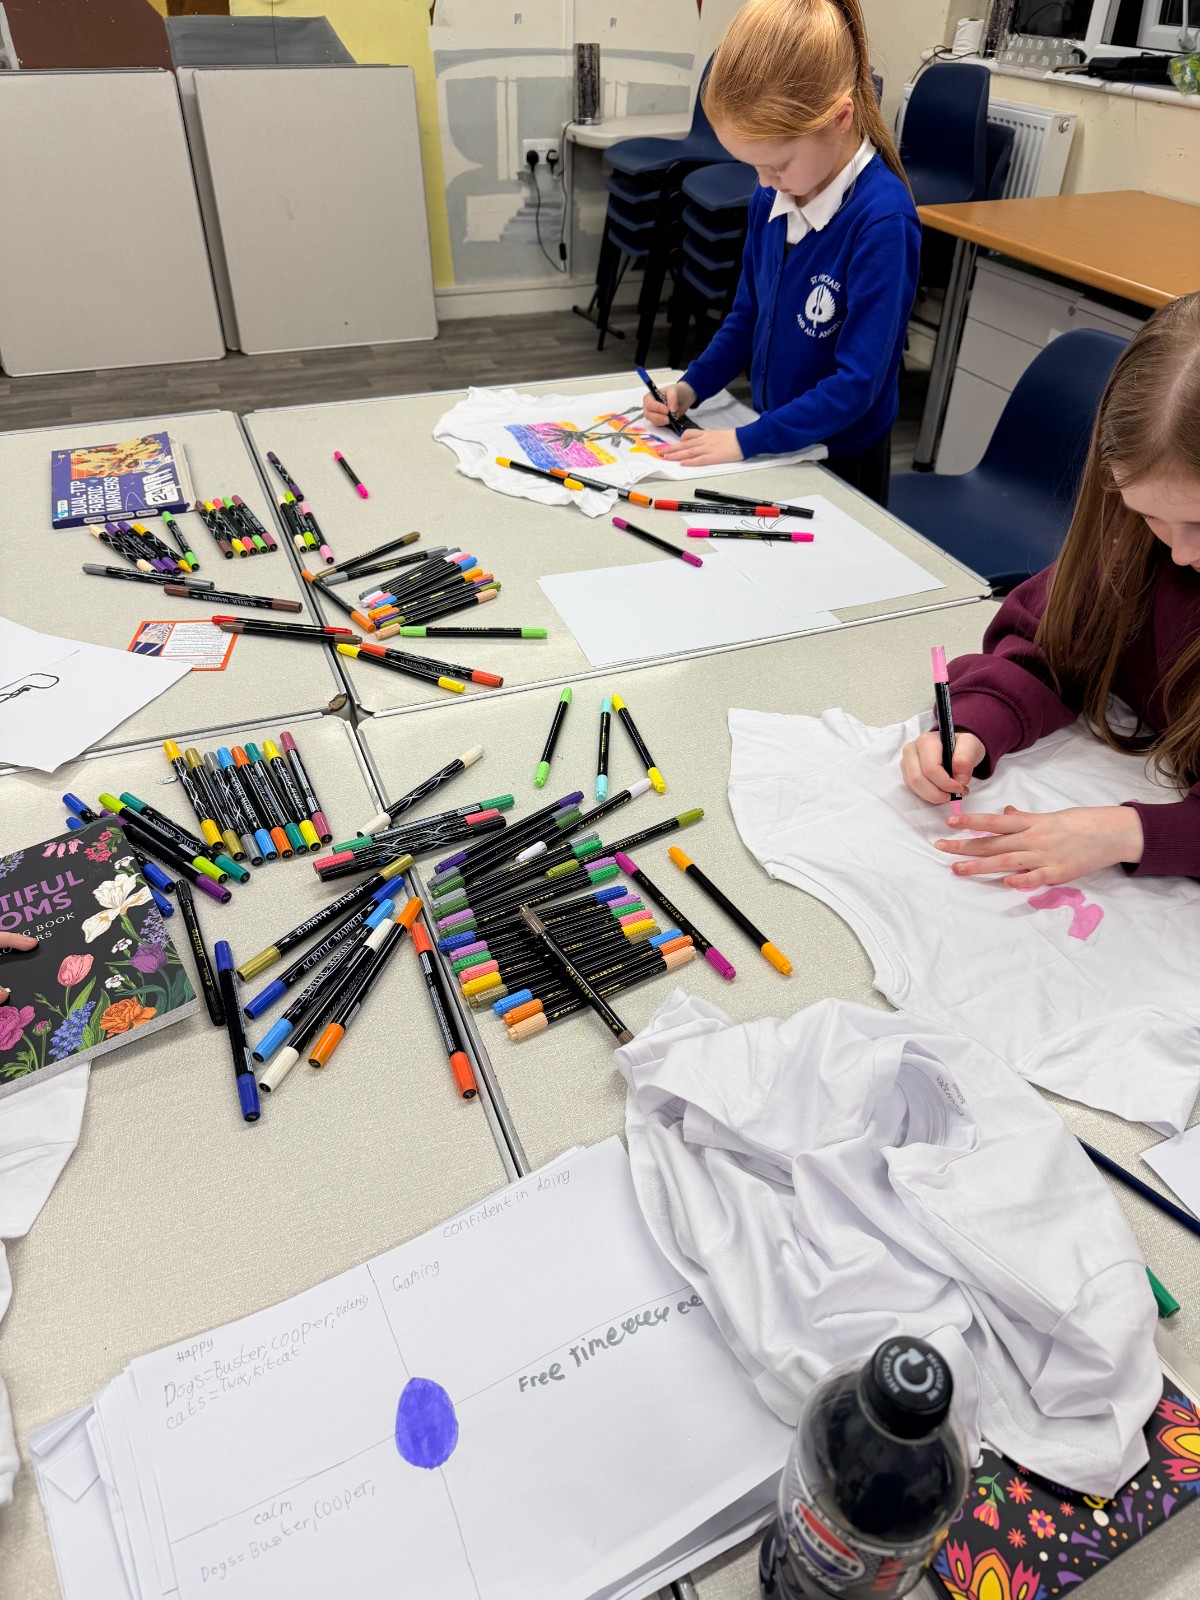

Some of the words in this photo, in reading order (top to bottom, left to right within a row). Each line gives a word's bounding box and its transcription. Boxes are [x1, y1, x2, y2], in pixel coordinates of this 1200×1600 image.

[810, 275, 818, 285] ST
[796, 313, 806, 329] AND
[804, 328, 816, 338] ALL
[70, 480, 88, 516] DUAL-TIP
[87, 485, 104, 514] FABRIC
[103, 476, 123, 512] MARKERS
[332, 884, 364, 911] ACRYLIC
[659, 896, 685, 922] ARTISTRO
[36, 911, 76, 931] BOOK
[296, 909, 331, 936] MARKER
[191, 928, 205, 957] ARTISTRO
[302, 943, 335, 972] ACRYLIC
[332, 913, 364, 944] MARKER
[565, 965, 594, 998] ARTISTRO
[950, 1082, 965, 1104] School
[515, 1190, 529, 1204] in
[537, 1169, 571, 1192] doing
[392, 1260, 440, 1292] Gaming
[176, 1338, 214, 1362] Happy
[518, 1362, 566, 1392] Free
[926, 1352, 944, 1390] RECYCLE
[253, 1500, 293, 1526] calm
